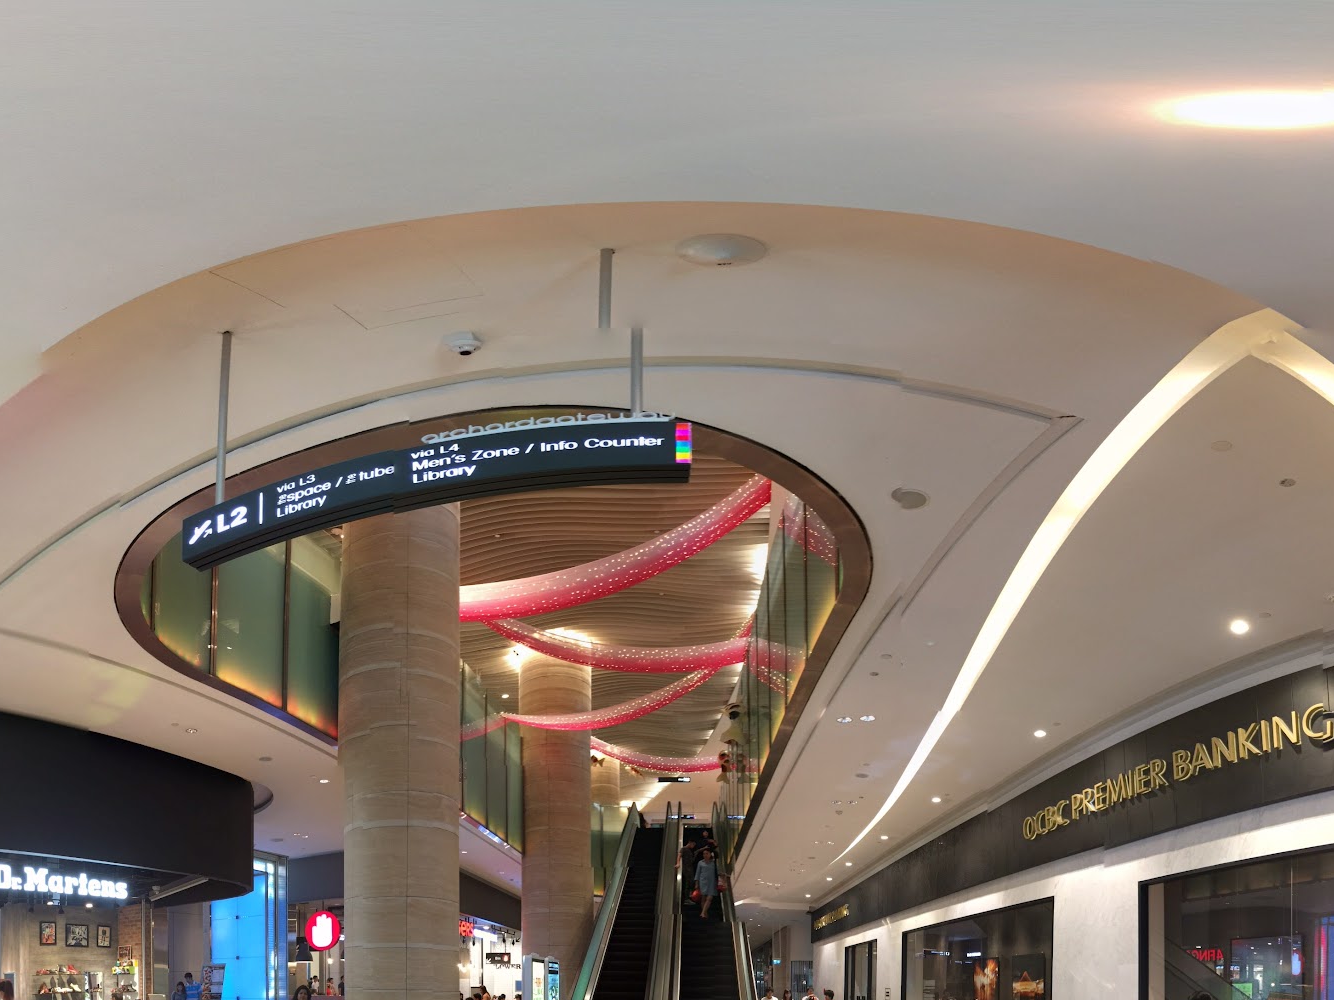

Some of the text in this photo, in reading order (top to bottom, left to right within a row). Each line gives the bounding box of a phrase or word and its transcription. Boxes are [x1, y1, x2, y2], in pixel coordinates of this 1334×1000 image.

[421, 411, 675, 444] orchardgateway
[411, 443, 460, 459] via L4
[412, 453, 466, 472] Men's
[472, 446, 520, 462] Zone
[540, 441, 578, 453] Info
[583, 436, 665, 449] Counter
[276, 474, 316, 494] via L3
[359, 465, 395, 481] tube
[412, 465, 477, 484] Library
[276, 495, 327, 518] Library
[217, 506, 248, 533] L2
[1022, 799, 1070, 840] OCBC
[1071, 758, 1169, 820] PREMIER
[23, 867, 128, 899] Martens
